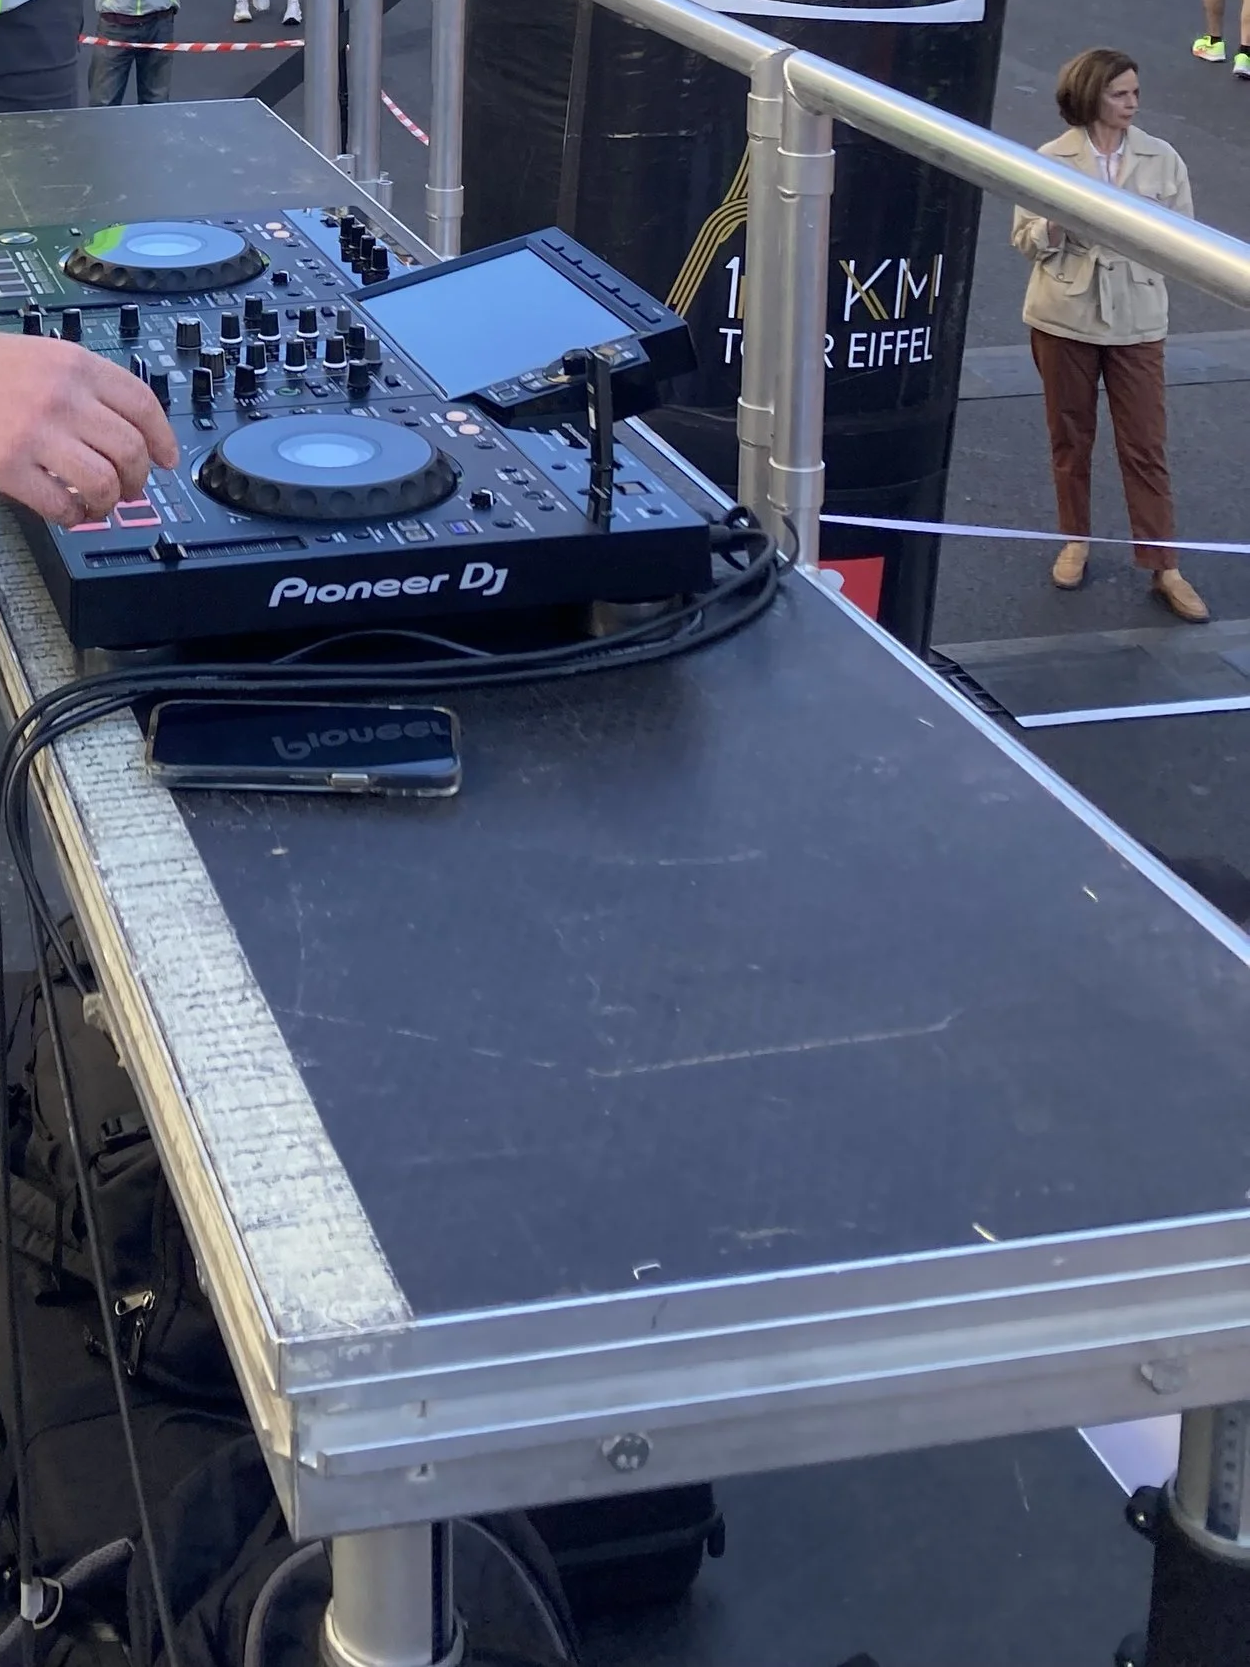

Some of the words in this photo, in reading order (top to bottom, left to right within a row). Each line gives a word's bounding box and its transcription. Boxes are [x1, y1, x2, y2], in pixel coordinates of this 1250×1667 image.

[838, 254, 943, 322] KM
[848, 326, 932, 369] EIFFEL
[268, 574, 449, 607] Pioneer
[459, 562, 508, 596] DJ
